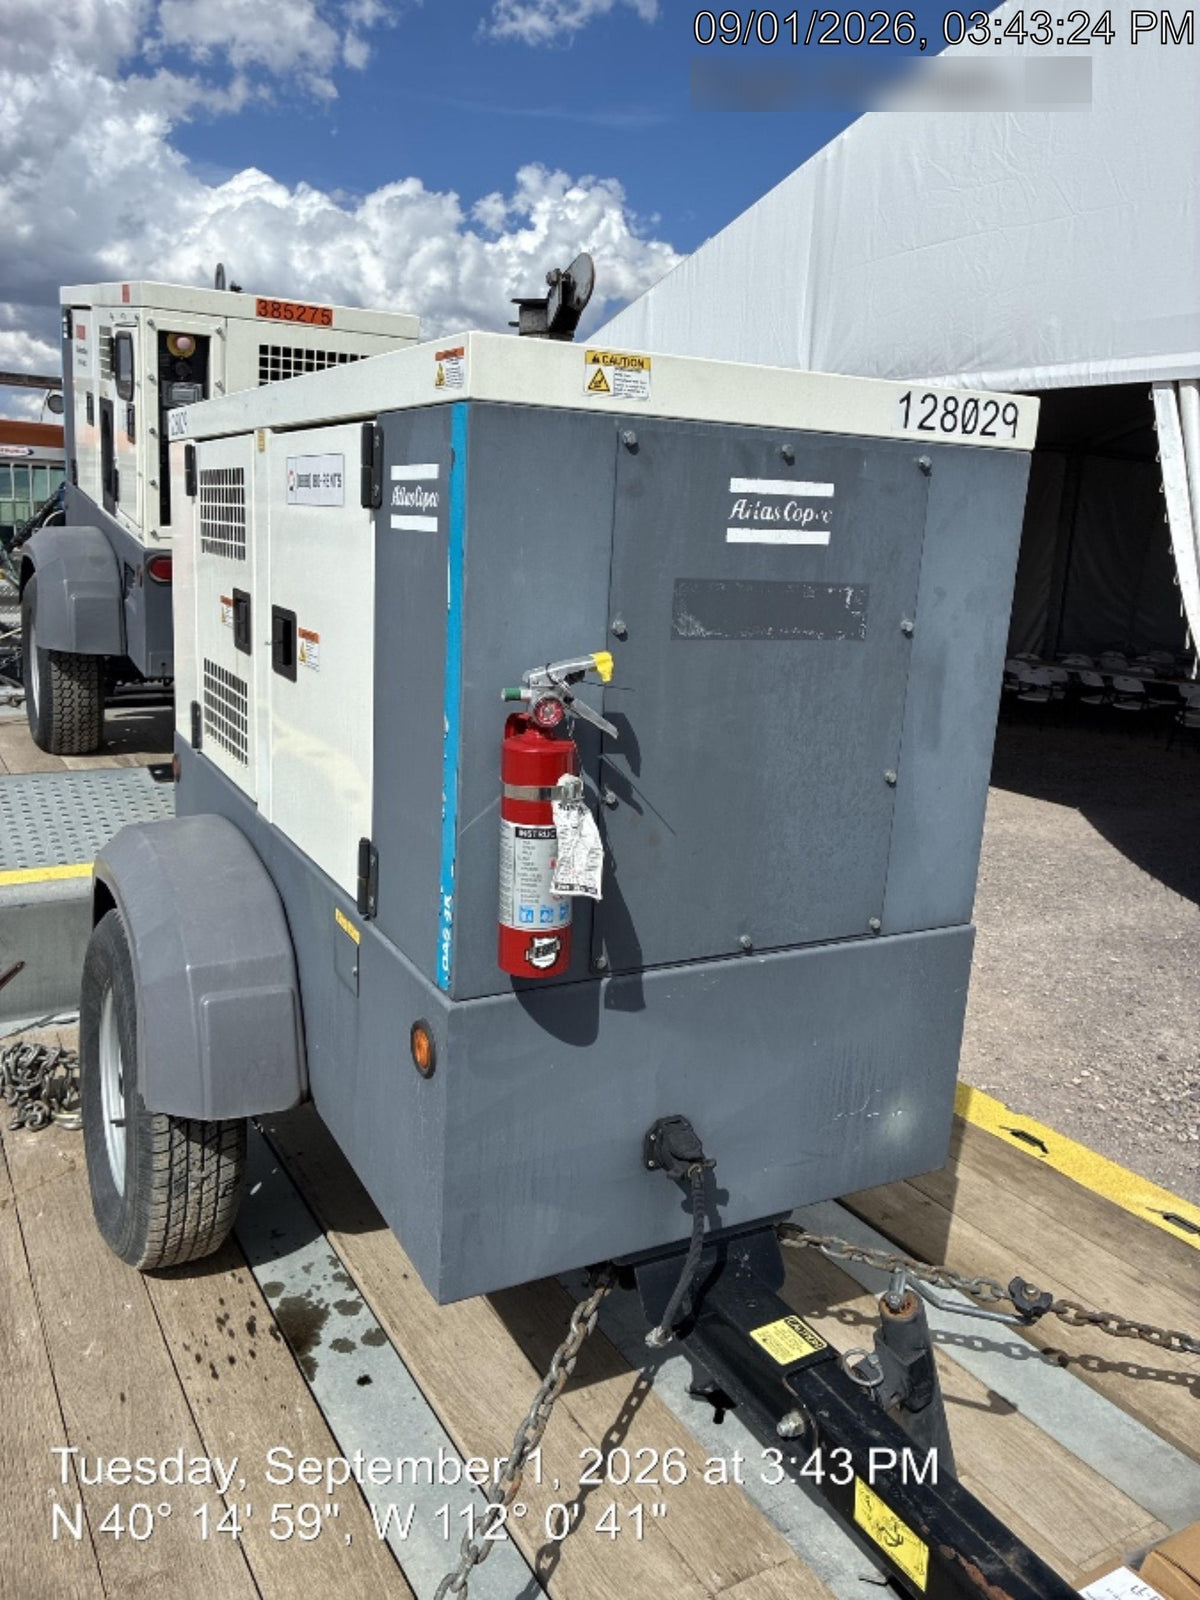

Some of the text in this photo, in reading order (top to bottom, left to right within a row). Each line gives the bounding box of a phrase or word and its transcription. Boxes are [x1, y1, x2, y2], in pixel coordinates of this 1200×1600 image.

[258, 299, 332, 325] 385275
[602, 355, 645, 369] CAUTION
[898, 390, 1019, 439] 128029
[518, 828, 556, 839] INSTRUC
